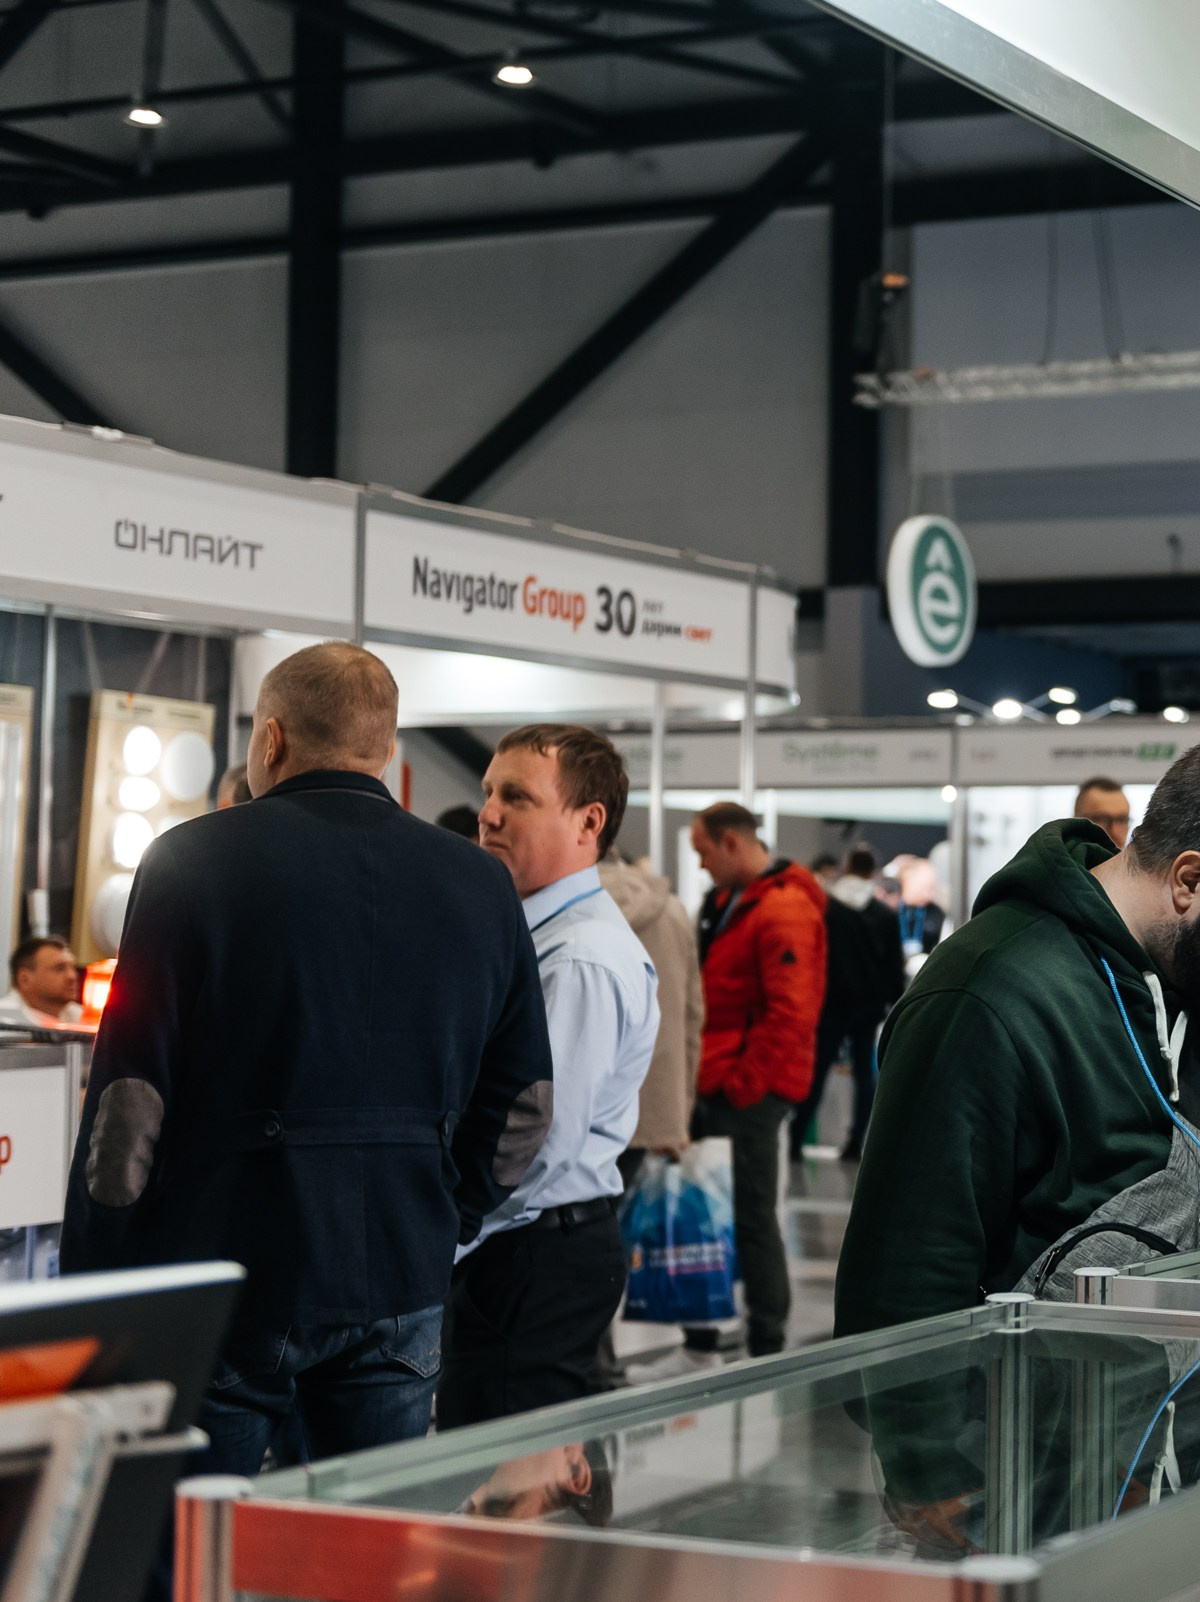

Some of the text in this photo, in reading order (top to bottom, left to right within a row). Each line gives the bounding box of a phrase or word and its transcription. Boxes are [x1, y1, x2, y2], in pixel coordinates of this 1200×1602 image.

[115, 519, 264, 570] ОНЛАЙТ
[412, 555, 637, 637] Navigator Group 30
